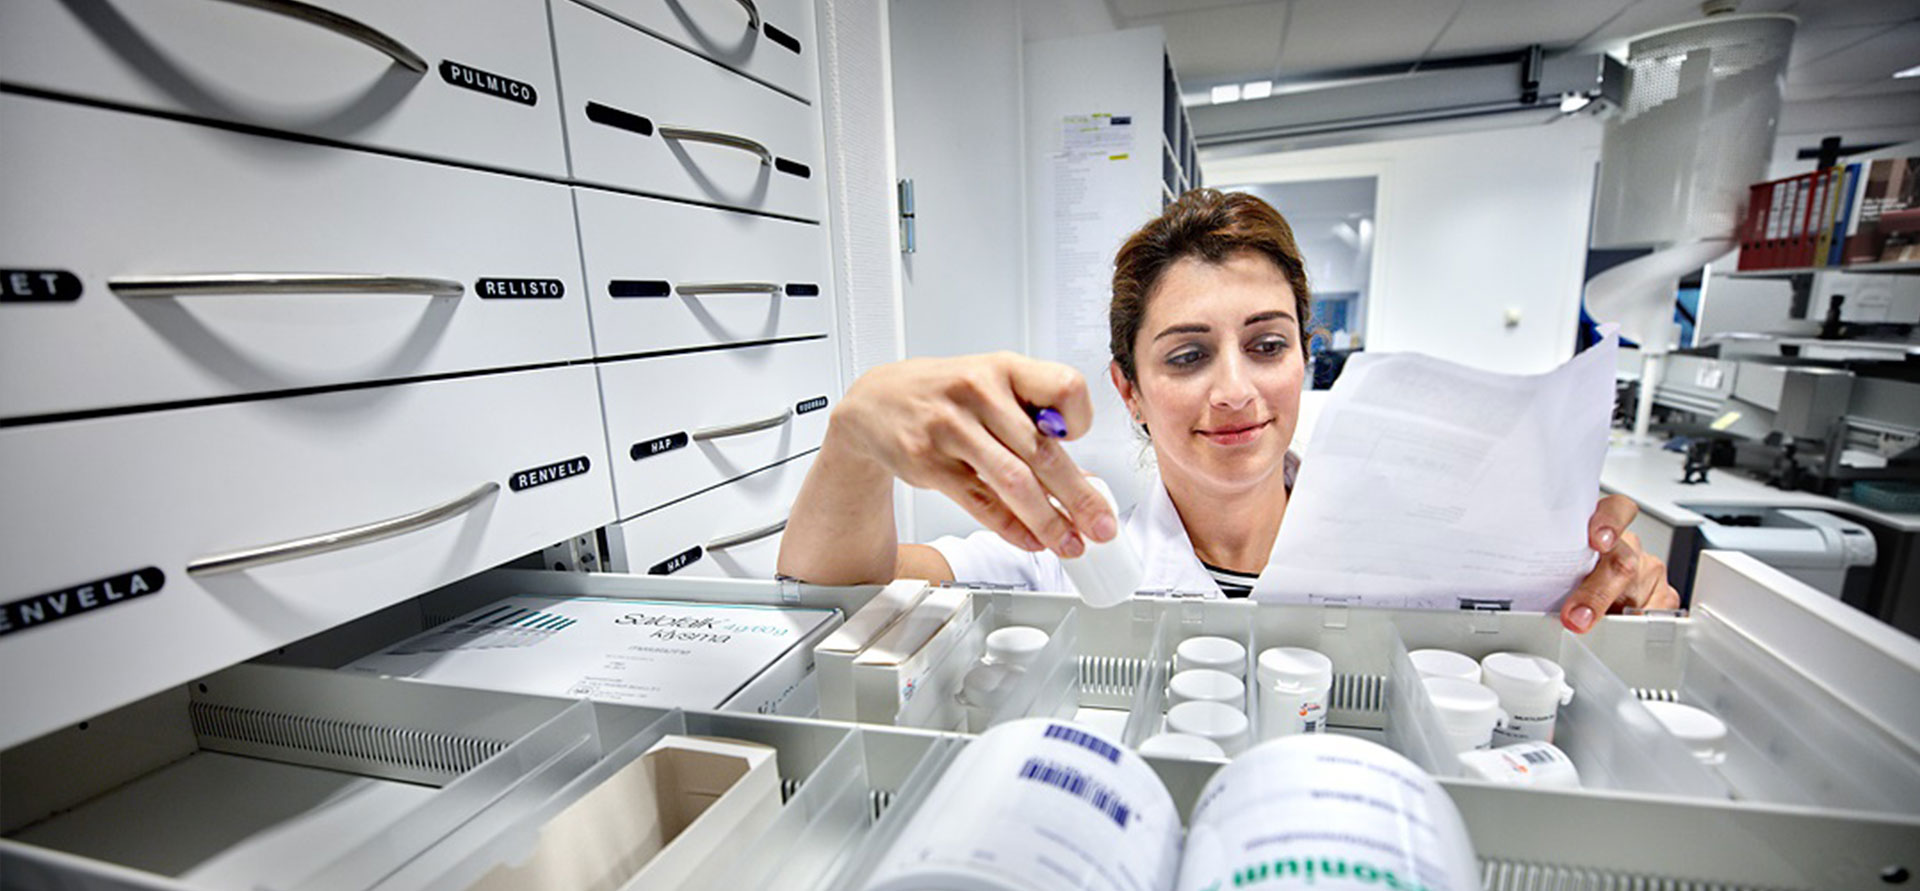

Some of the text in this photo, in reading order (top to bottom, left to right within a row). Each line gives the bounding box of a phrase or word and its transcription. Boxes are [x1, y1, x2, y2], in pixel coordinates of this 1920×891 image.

[451, 64, 530, 100] PULMICO
[0, 273, 58, 295] ET
[485, 281, 559, 296] RELISTO
[651, 438, 672, 453] HAP
[518, 460, 585, 488] RENVELA
[667, 554, 687, 572] HAP
[1212, 856, 1430, 891] sonium
